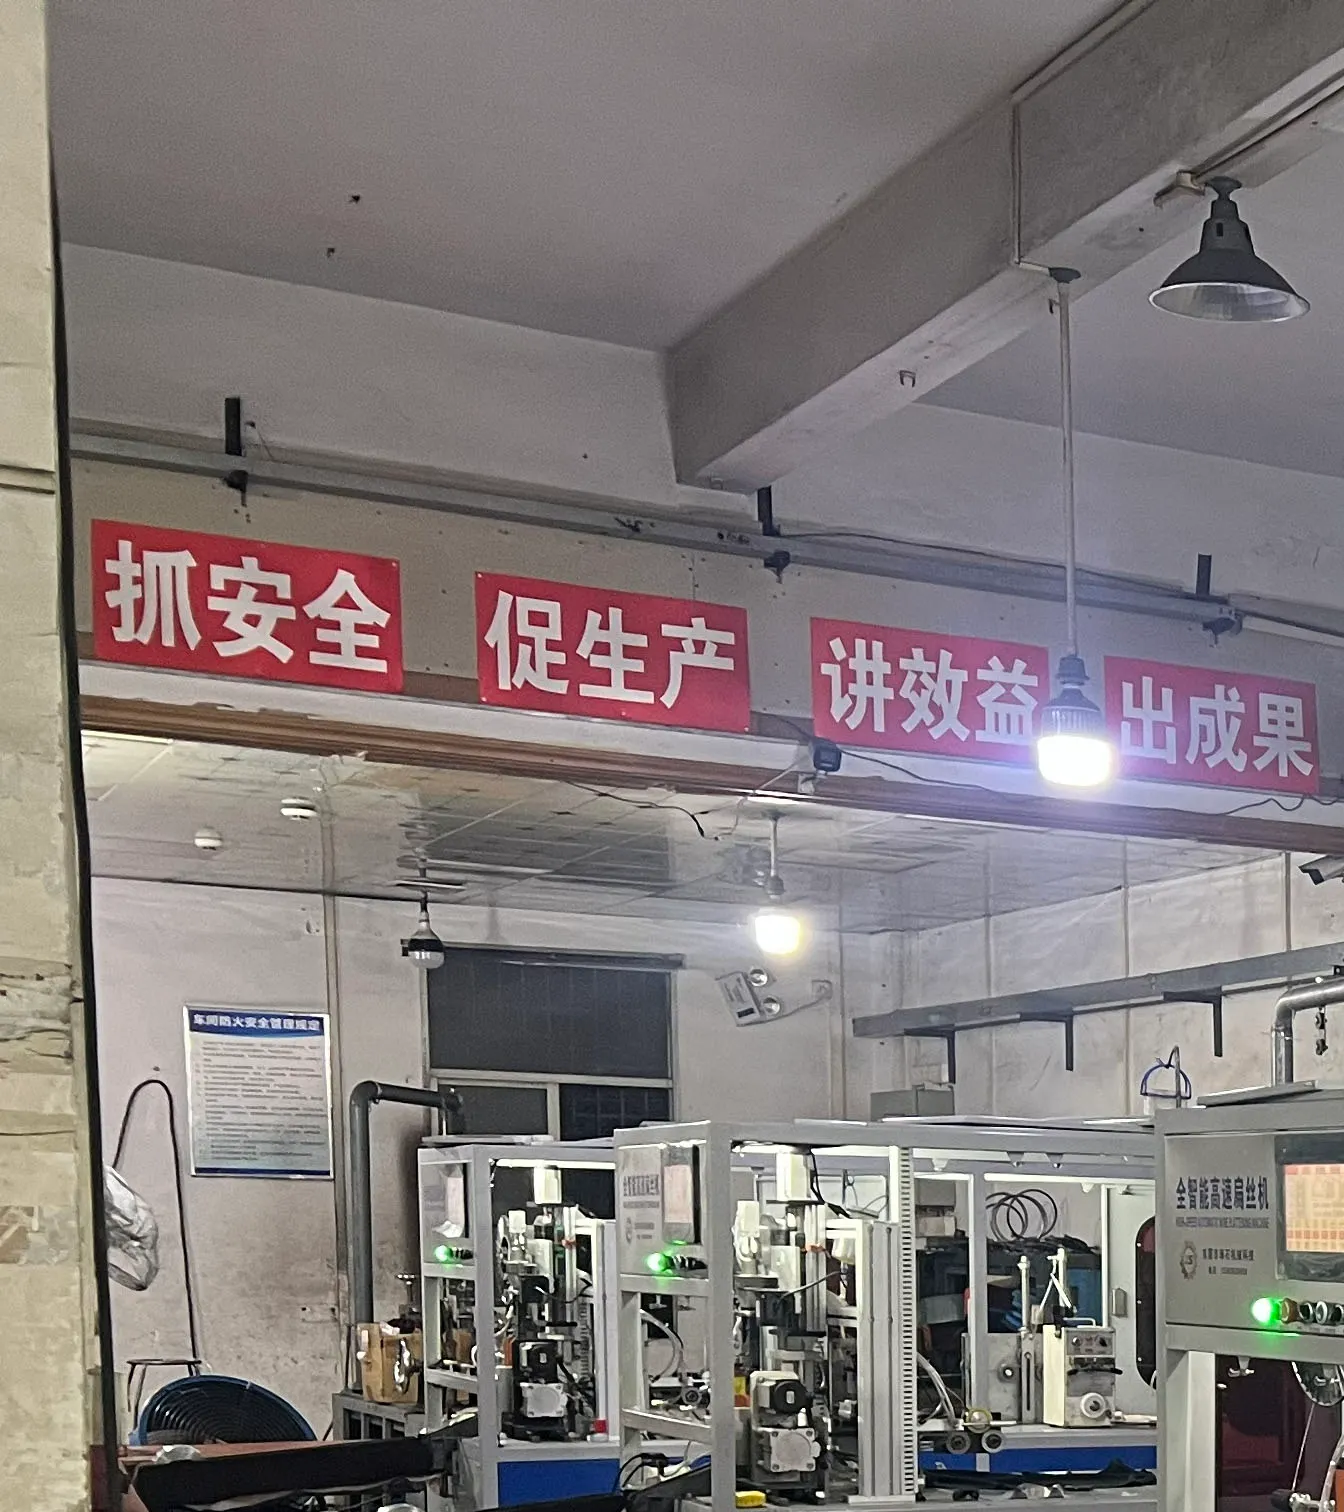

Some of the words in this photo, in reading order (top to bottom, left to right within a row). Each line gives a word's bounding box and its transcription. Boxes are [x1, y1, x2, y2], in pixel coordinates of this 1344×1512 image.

[104, 539, 391, 673] 抓安全
[483, 589, 736, 709] 促生产
[820, 636, 1039, 746] 讲效益
[1120, 675, 1315, 777] 出成果
[1175, 1175, 1269, 1211] 全智能高速扁丝机
